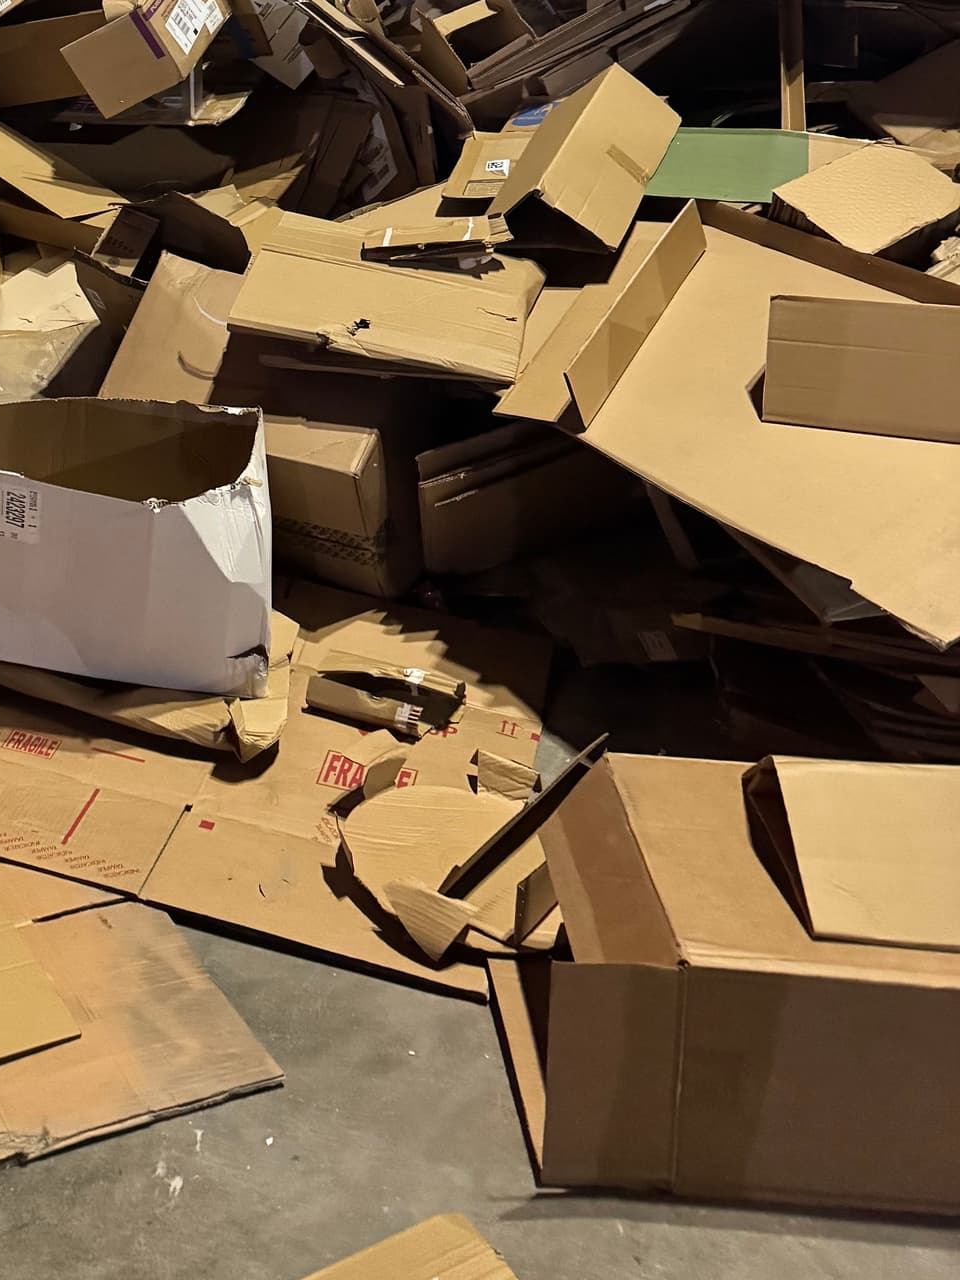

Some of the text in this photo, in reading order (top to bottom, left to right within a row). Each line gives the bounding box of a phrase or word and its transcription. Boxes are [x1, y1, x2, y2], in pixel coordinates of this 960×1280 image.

[5, 491, 26, 529] 2423297
[6, 729, 58, 757] FRAGILE
[323, 754, 412, 789] FRAE
